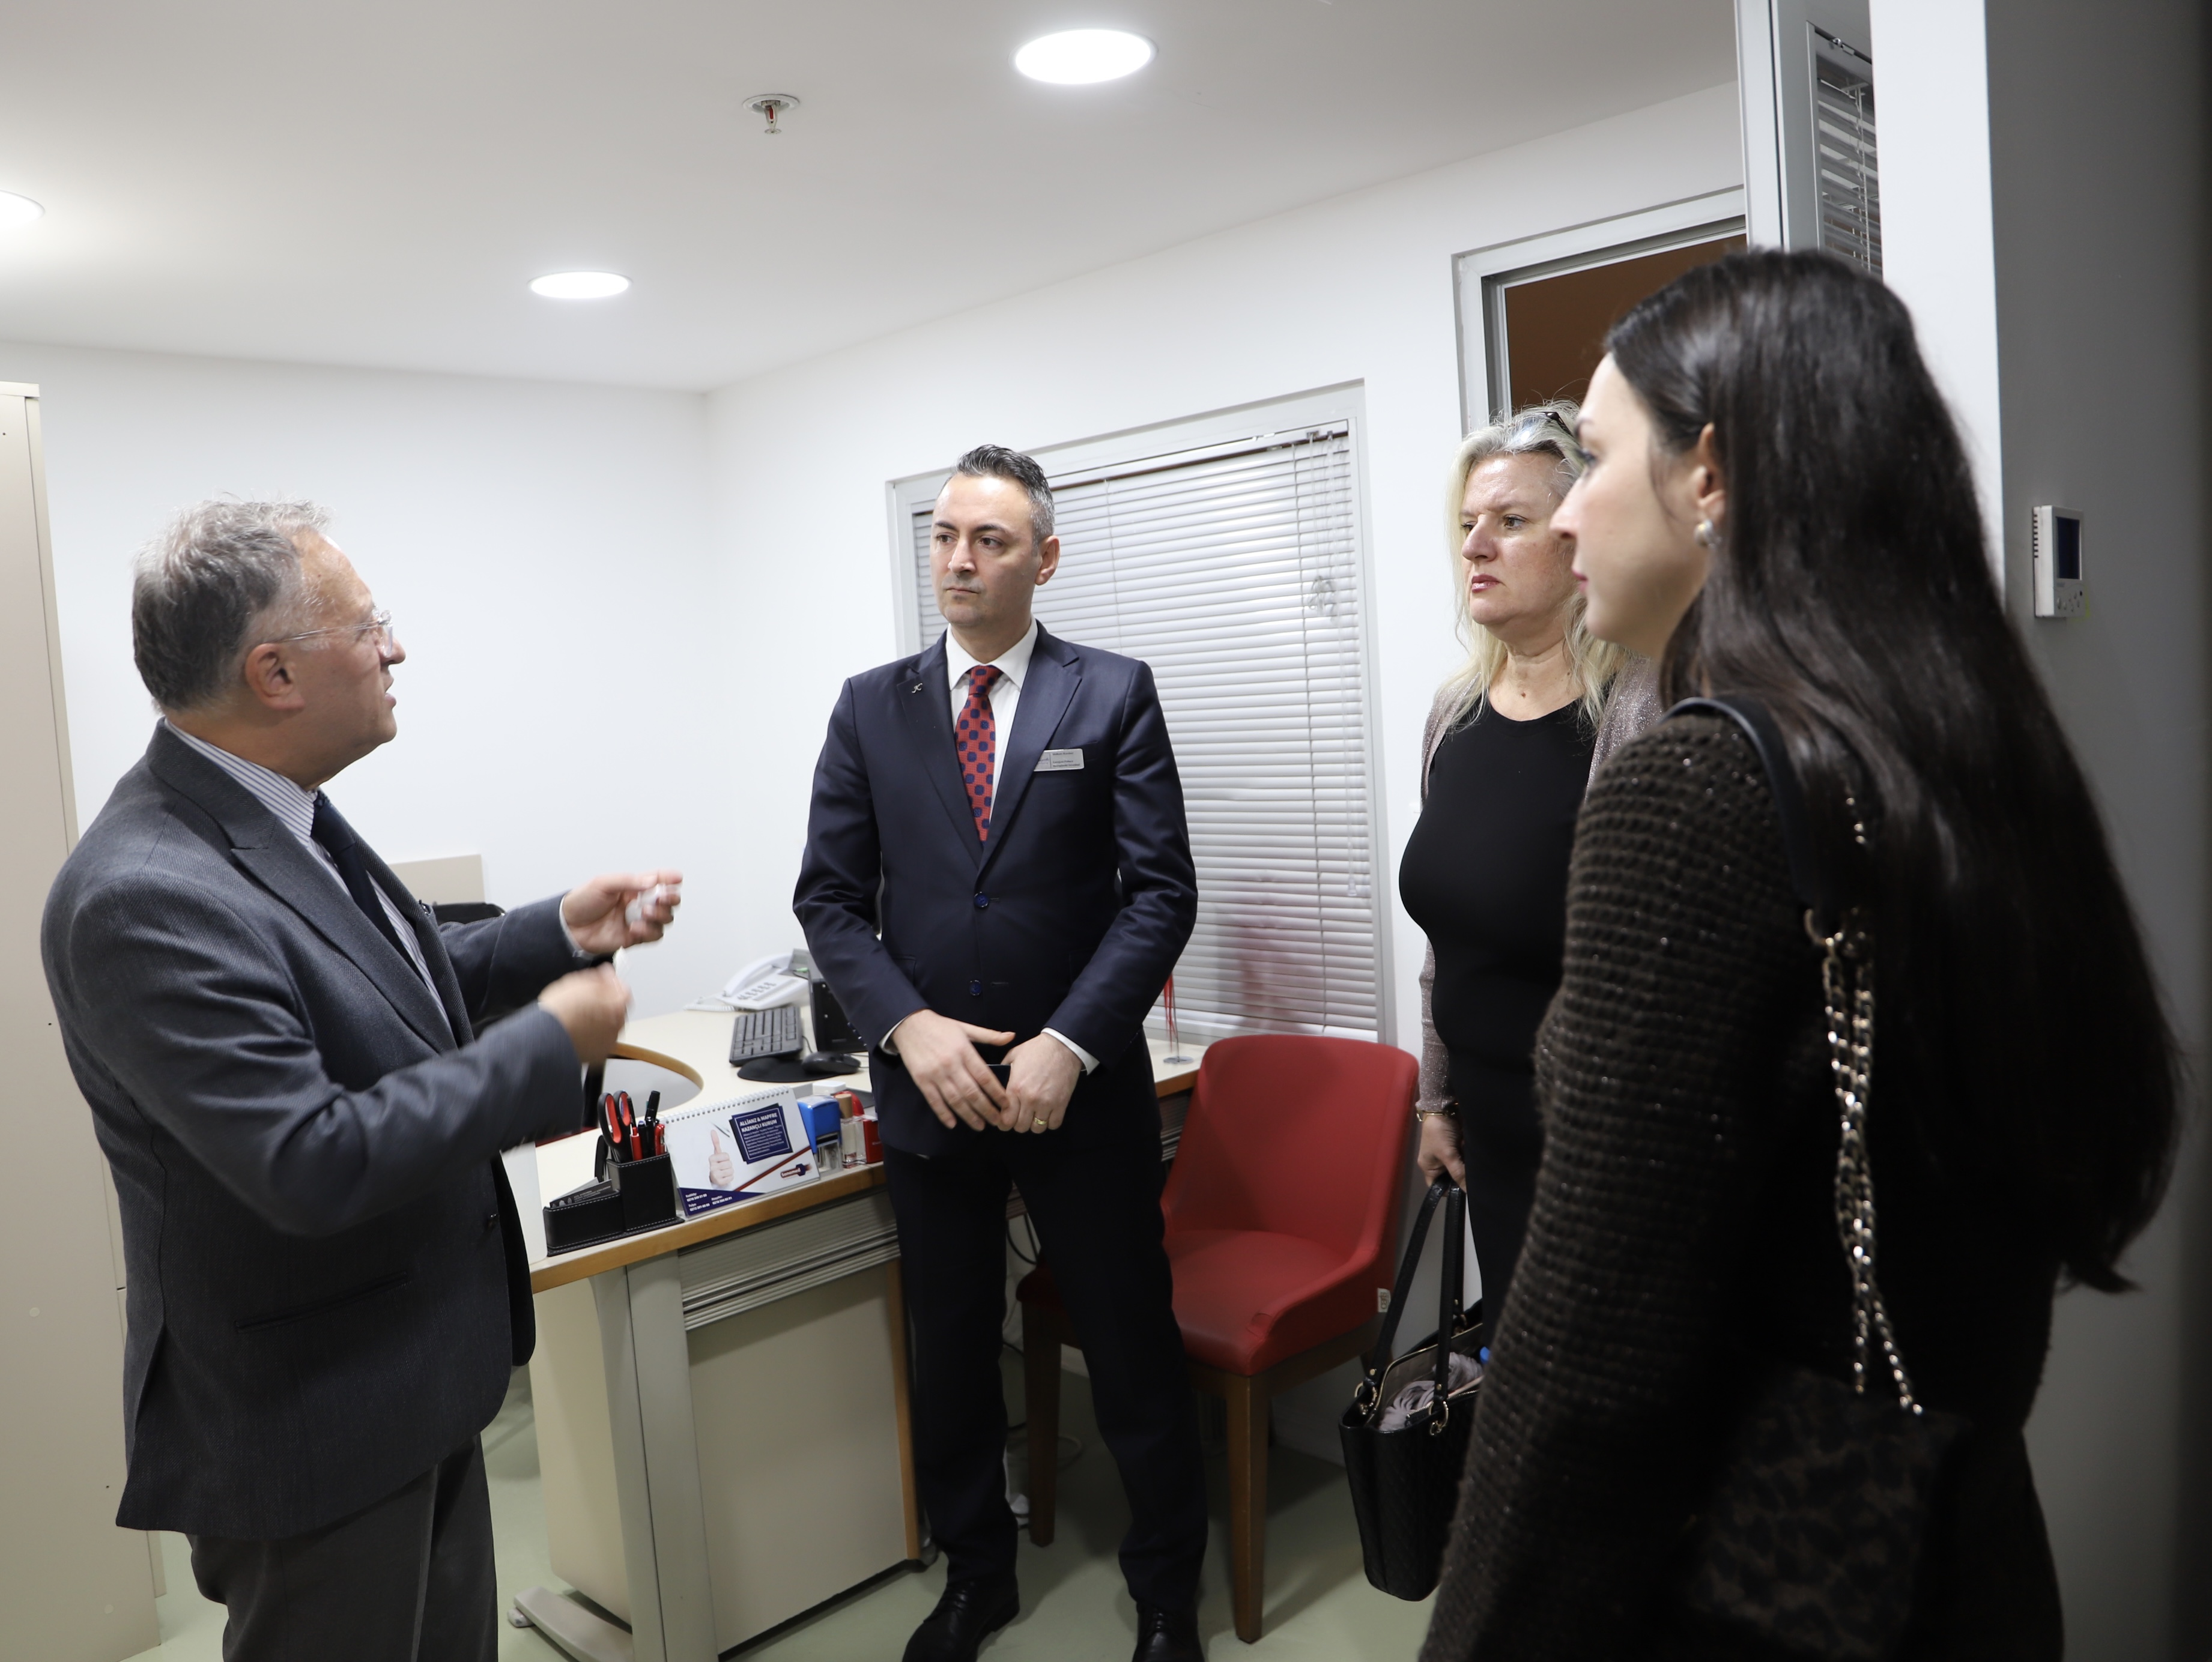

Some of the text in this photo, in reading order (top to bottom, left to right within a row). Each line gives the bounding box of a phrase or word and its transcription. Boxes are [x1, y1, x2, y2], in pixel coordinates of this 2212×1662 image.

[761, 1112, 778, 1121] MAPFRE
[741, 1119, 777, 1133] KAZANÇLI KURUM
